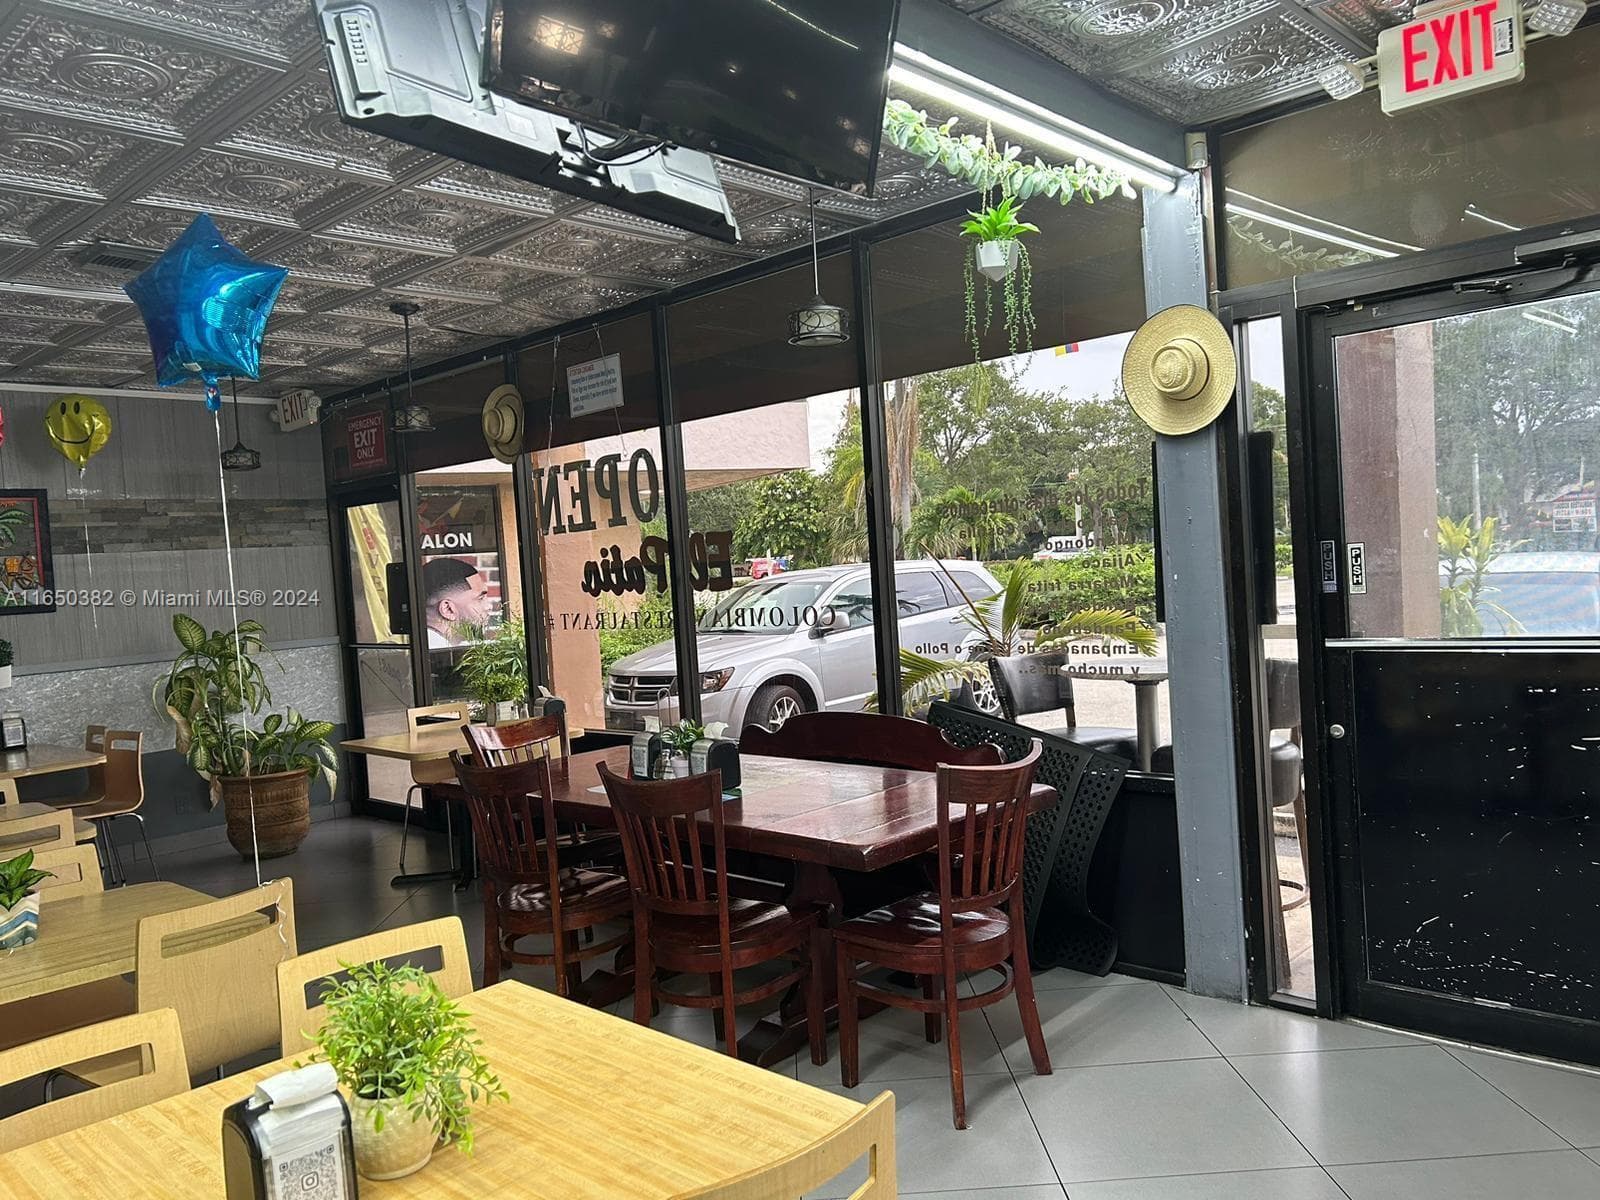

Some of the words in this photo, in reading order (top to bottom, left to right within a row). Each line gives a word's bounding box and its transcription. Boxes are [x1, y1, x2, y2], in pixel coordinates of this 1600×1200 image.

[1402, 2, 1497, 93] EXIT
[282, 393, 304, 424] EXIT
[348, 416, 382, 432] EMERGENCY
[354, 428, 378, 449] EXIT
[357, 446, 375, 460] ONLY
[421, 533, 473, 549] ALON
[1323, 543, 1333, 579] PUSH
[1352, 549, 1362, 583] PUSH
